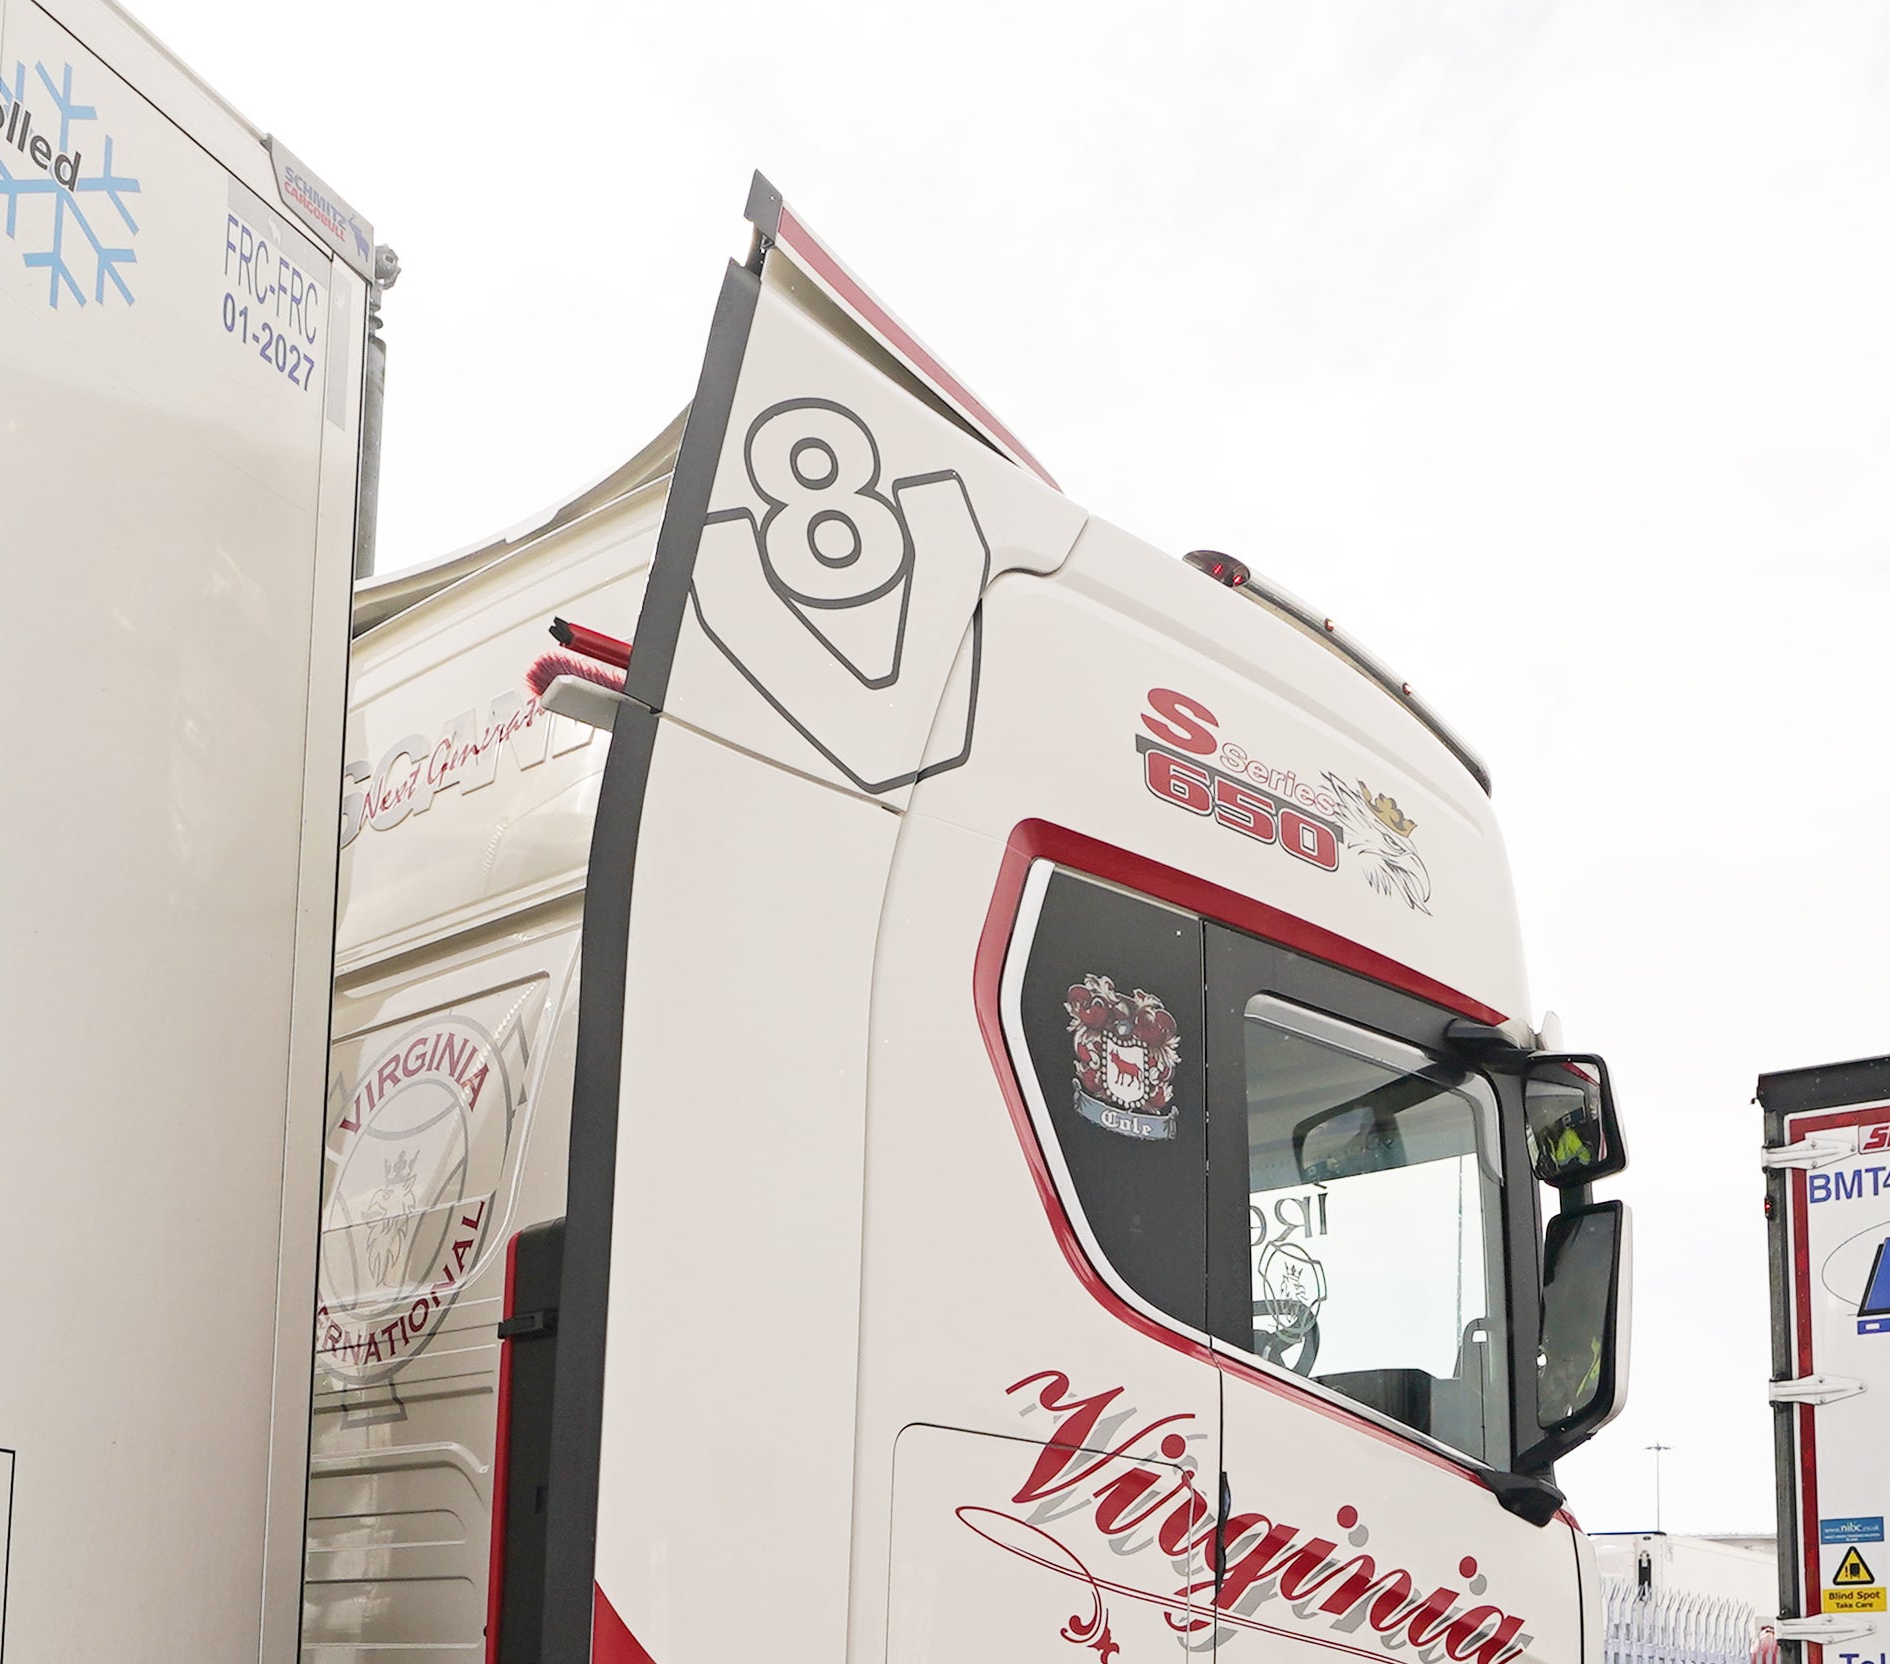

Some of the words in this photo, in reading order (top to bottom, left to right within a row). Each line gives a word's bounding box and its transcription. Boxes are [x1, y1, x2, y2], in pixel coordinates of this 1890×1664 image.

[284, 180, 347, 243] CARGOBULL
[285, 165, 348, 231] SCHMITZ
[224, 213, 318, 345] FRC-FRC
[223, 292, 315, 392] 01-2027
[358, 762, 421, 830] Next
[1143, 748, 1340, 872] 650
[339, 1031, 489, 1135] VIRGINIA
[1100, 1109, 1152, 1136] Cole
[1828, 1591, 1854, 1601] Blind
[1856, 1590, 1881, 1600] Spot
